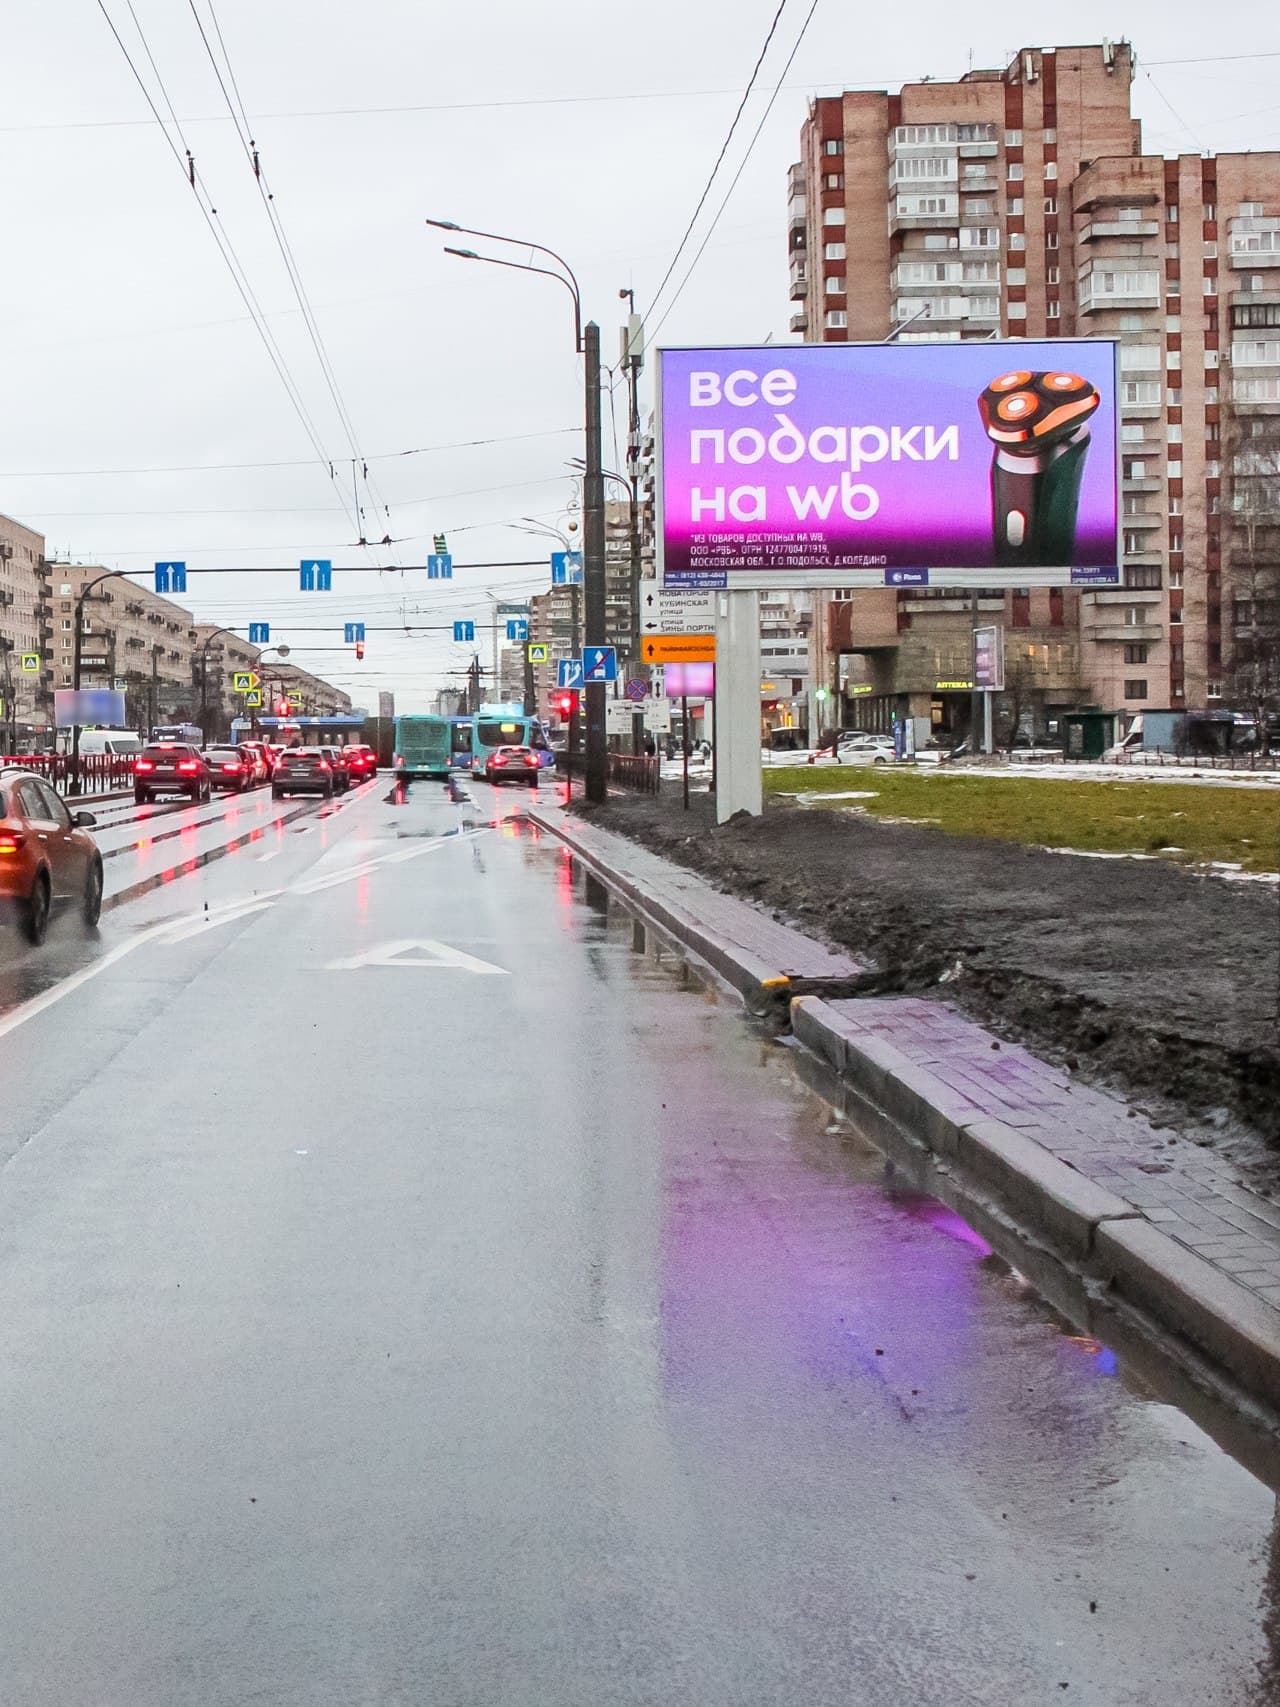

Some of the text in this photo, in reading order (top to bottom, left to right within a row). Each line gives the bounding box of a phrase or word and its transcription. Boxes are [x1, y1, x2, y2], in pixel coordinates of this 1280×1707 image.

[689, 368, 797, 406] все
[690, 413, 959, 472] подарки
[691, 471, 880, 522] на wb
[708, 533, 745, 543] ТОВАРОВ
[746, 532, 795, 544] ДОСТУПНЫХ
[797, 532, 808, 542] НА
[690, 545, 709, 555] ООО
[741, 545, 762, 555] ОГРН
[690, 557, 745, 567] МОСКОВСКАЯ
[659, 599, 709, 608] КУБИНСКАЯ
[660, 608, 684, 616] улица
[936, 681, 968, 689] АПТЕКА
